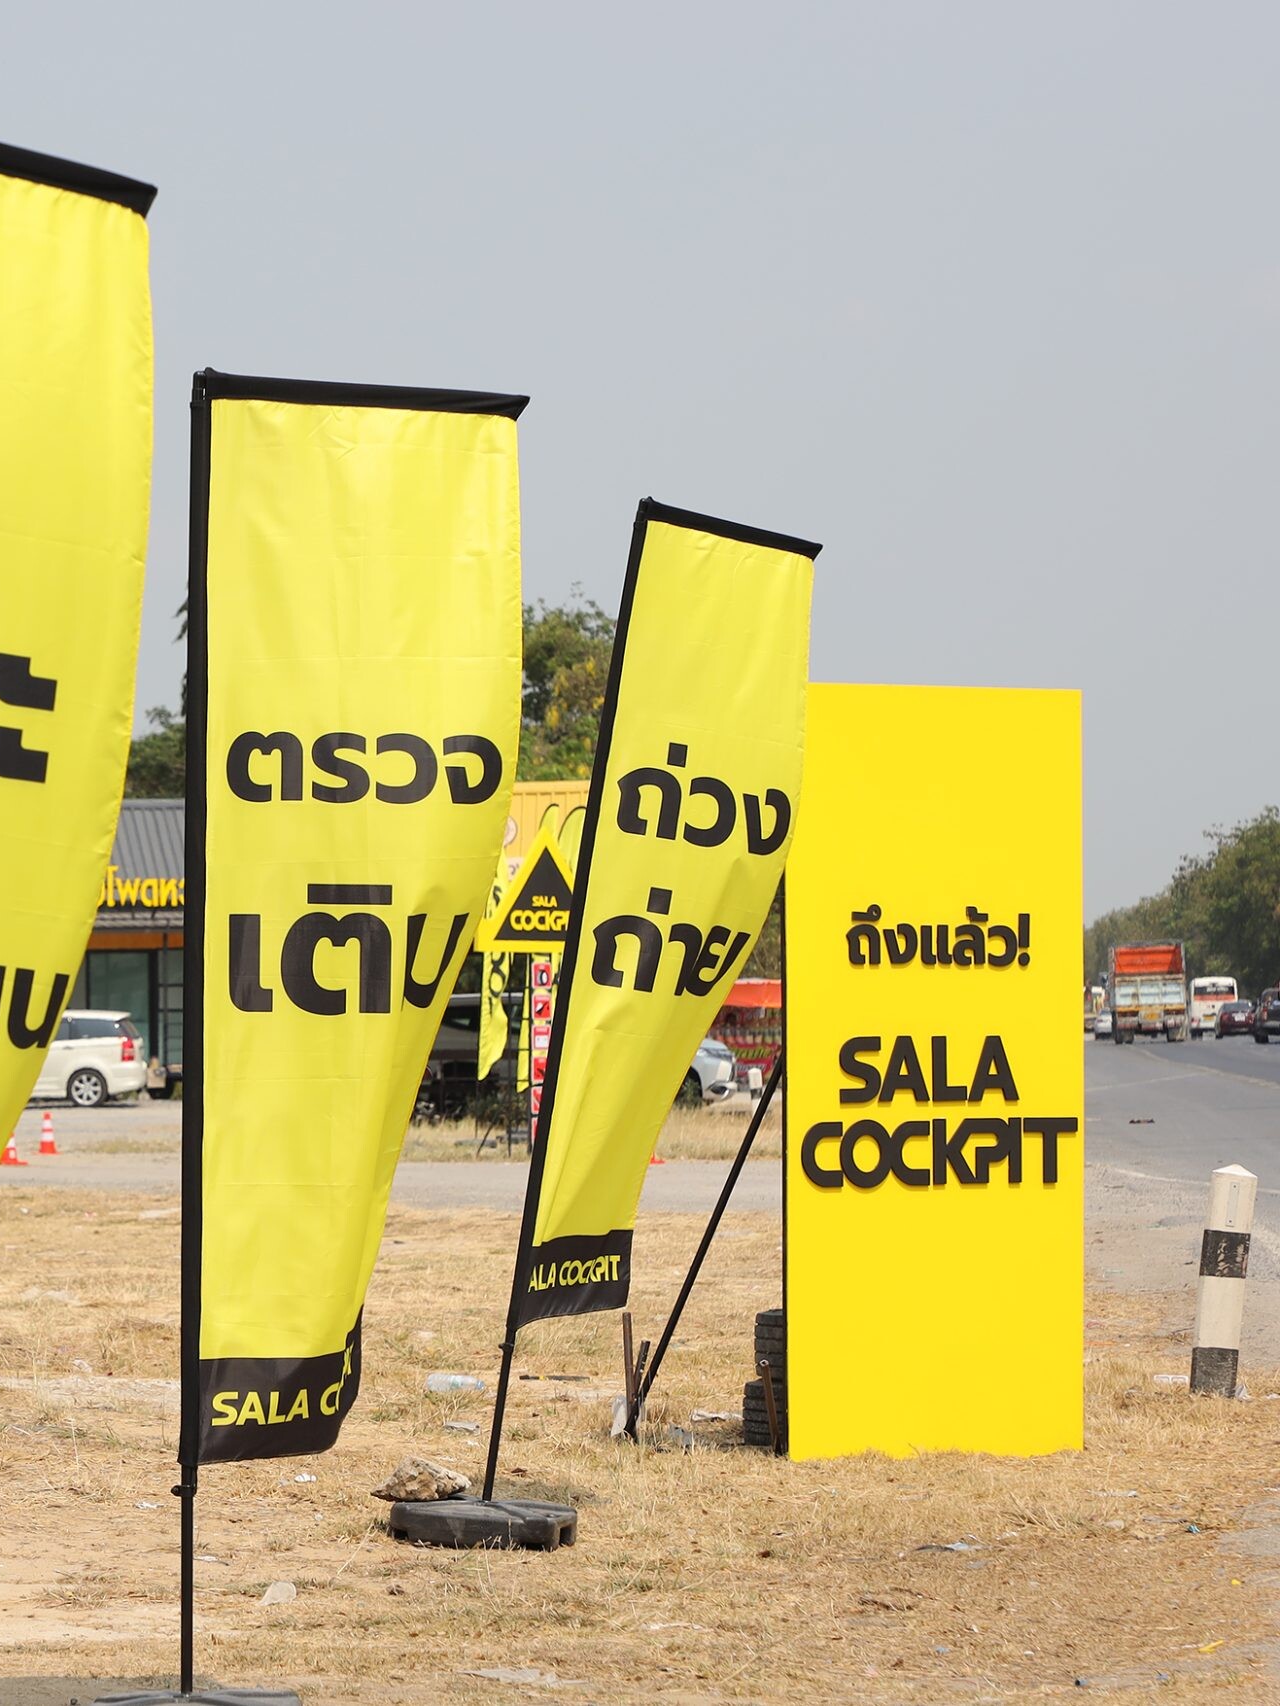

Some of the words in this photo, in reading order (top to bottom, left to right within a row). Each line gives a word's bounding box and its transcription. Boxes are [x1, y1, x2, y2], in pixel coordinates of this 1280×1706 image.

[226, 731, 503, 805] ตรวจ
[617, 742, 792, 856] ถ่วง
[531, 895, 558, 908] SALA
[846, 904, 1030, 967] ถึงแล้ว!
[228, 884, 471, 1016] เติม
[591, 887, 751, 997] ถ่าย
[839, 1035, 1020, 1104] SALA
[801, 1117, 1078, 1189] COCKPIT
[211, 1388, 310, 1427] SALA
